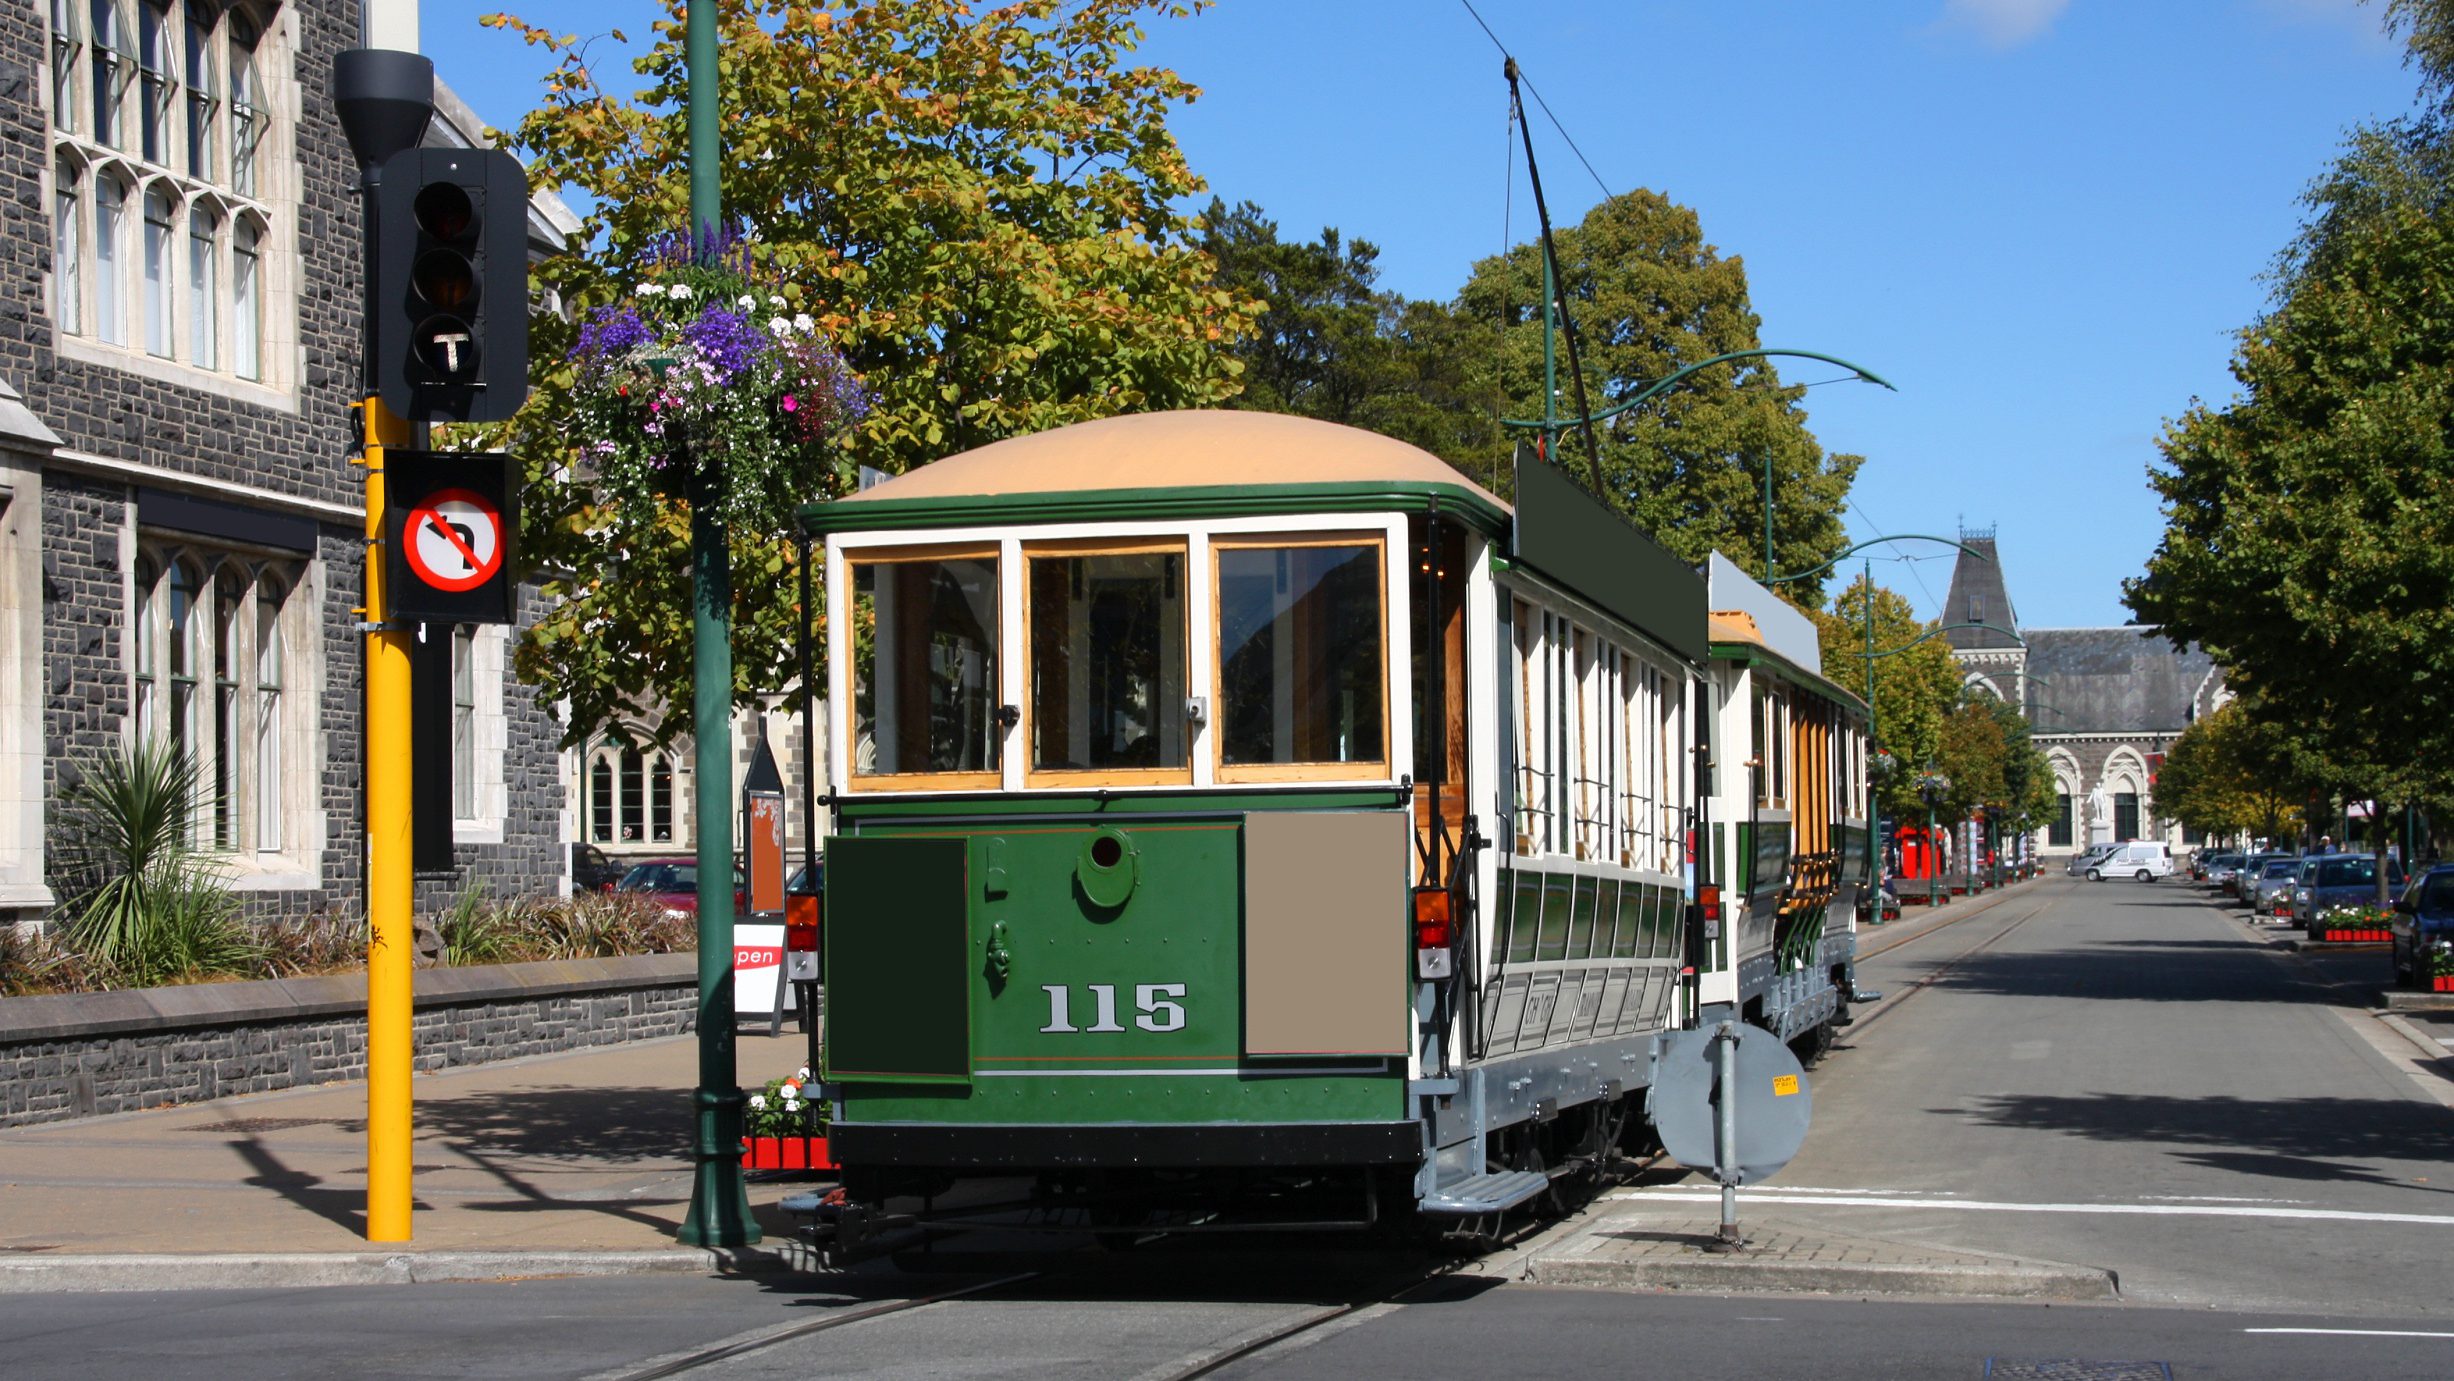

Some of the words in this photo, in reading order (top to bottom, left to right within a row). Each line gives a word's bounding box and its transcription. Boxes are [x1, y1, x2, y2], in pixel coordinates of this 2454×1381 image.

[433, 333, 469, 372] T
[734, 951, 773, 966] pen
[1039, 983, 1187, 1034] 115
